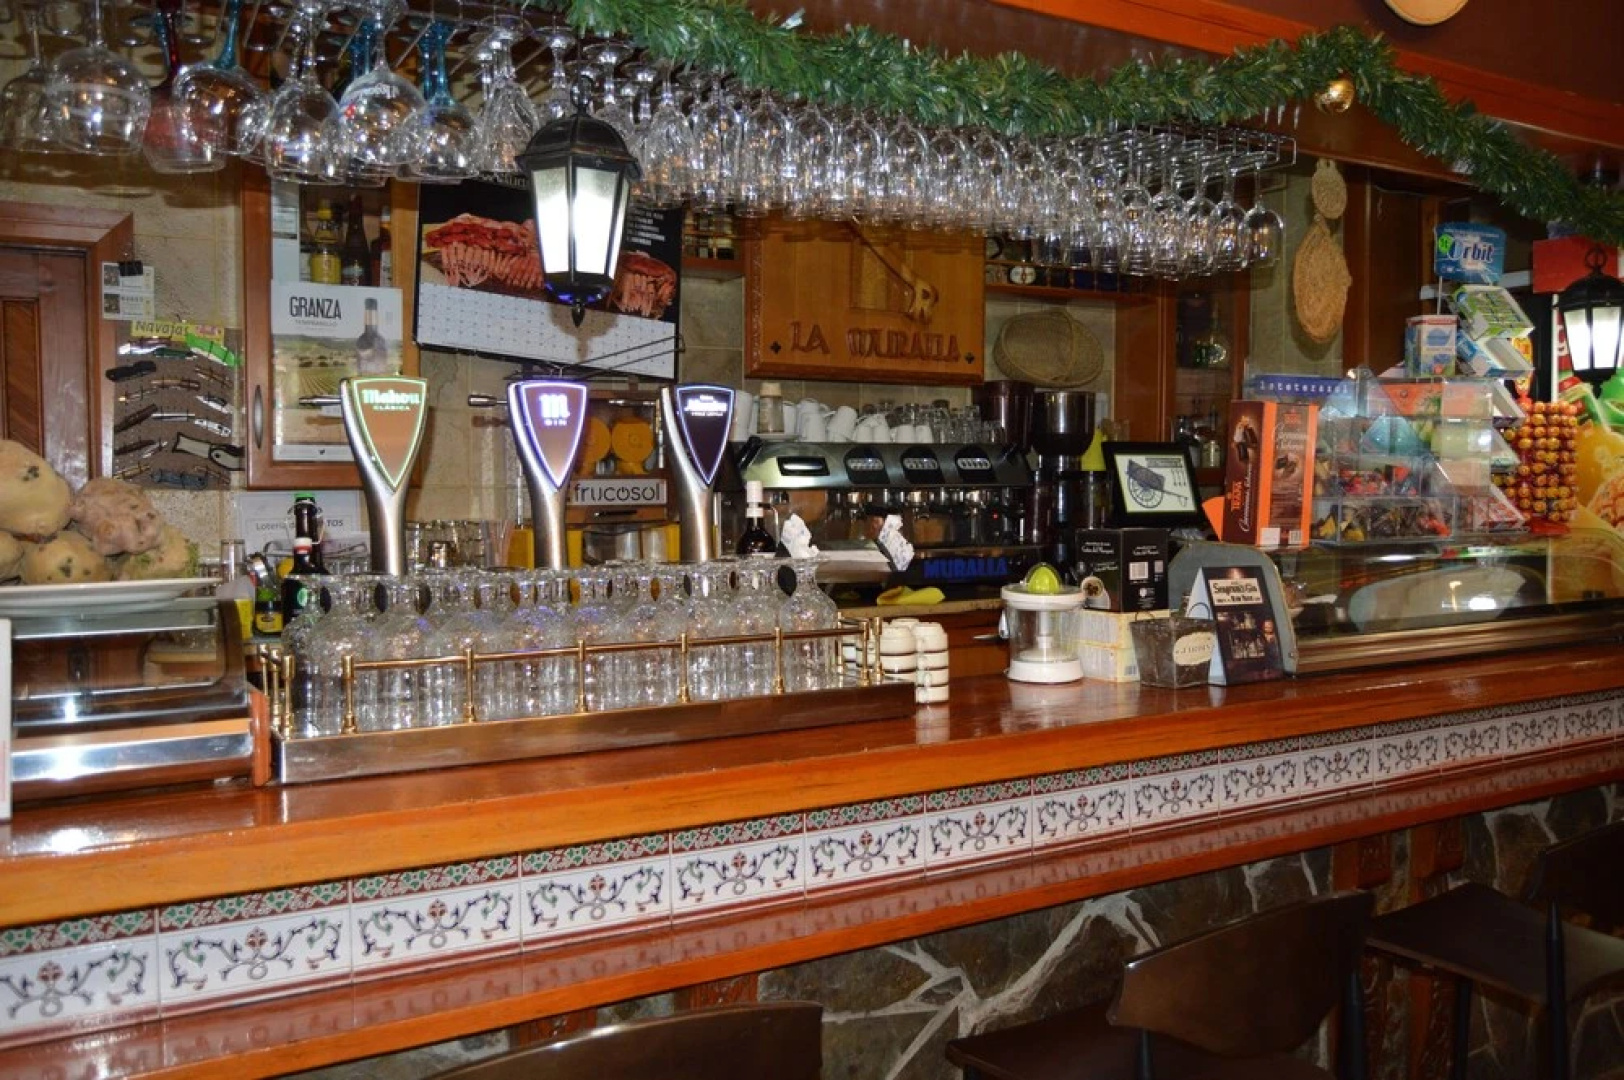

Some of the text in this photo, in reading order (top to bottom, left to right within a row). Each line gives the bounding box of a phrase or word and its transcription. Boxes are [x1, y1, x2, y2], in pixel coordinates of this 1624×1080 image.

[1446, 241, 1494, 262] Orbit
[289, 296, 341, 320] GRANZA
[791, 321, 830, 355] LA
[362, 389, 420, 405] Mahou
[574, 483, 660, 502] frucosol
[923, 557, 1008, 578] MURALLA
